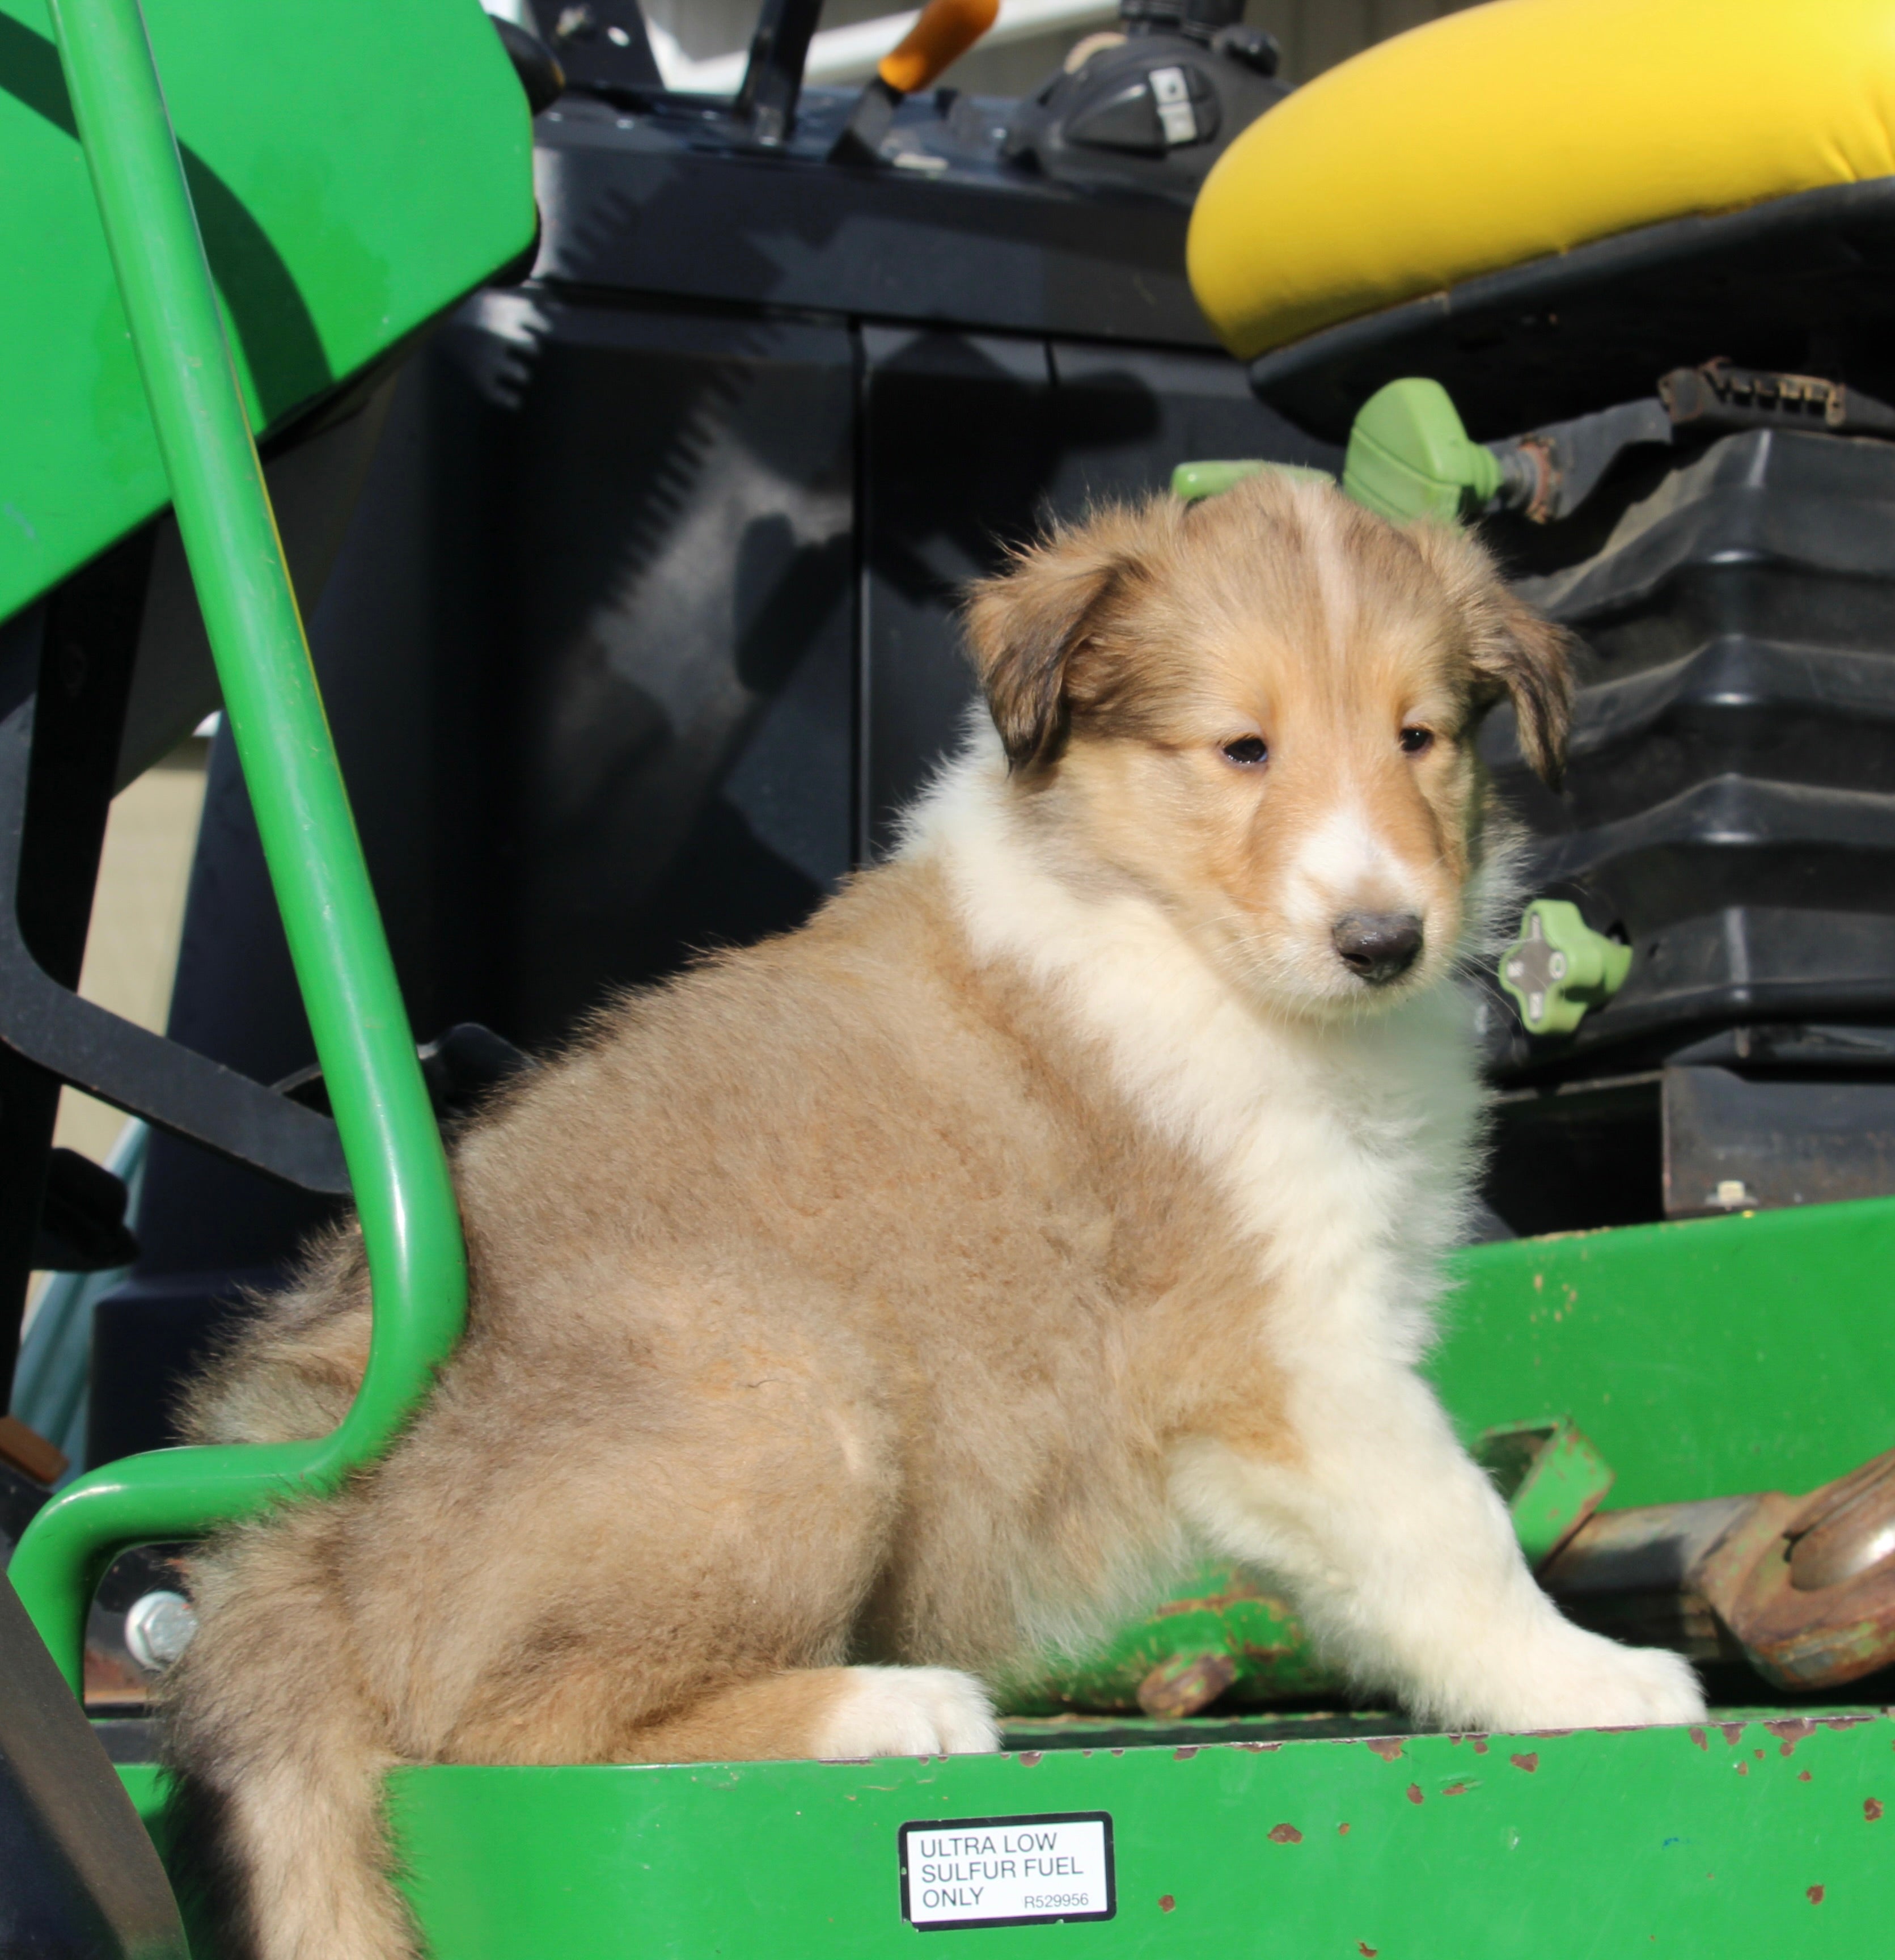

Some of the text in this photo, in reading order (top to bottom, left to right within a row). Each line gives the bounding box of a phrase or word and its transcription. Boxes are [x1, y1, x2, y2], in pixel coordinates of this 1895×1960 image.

[920, 1832, 1058, 1858] ULTRA LOW
[921, 1856, 1084, 1883] SULFUR FUEL
[923, 1887, 984, 1908] ONLY
[1024, 1893, 1089, 1908] R529956
